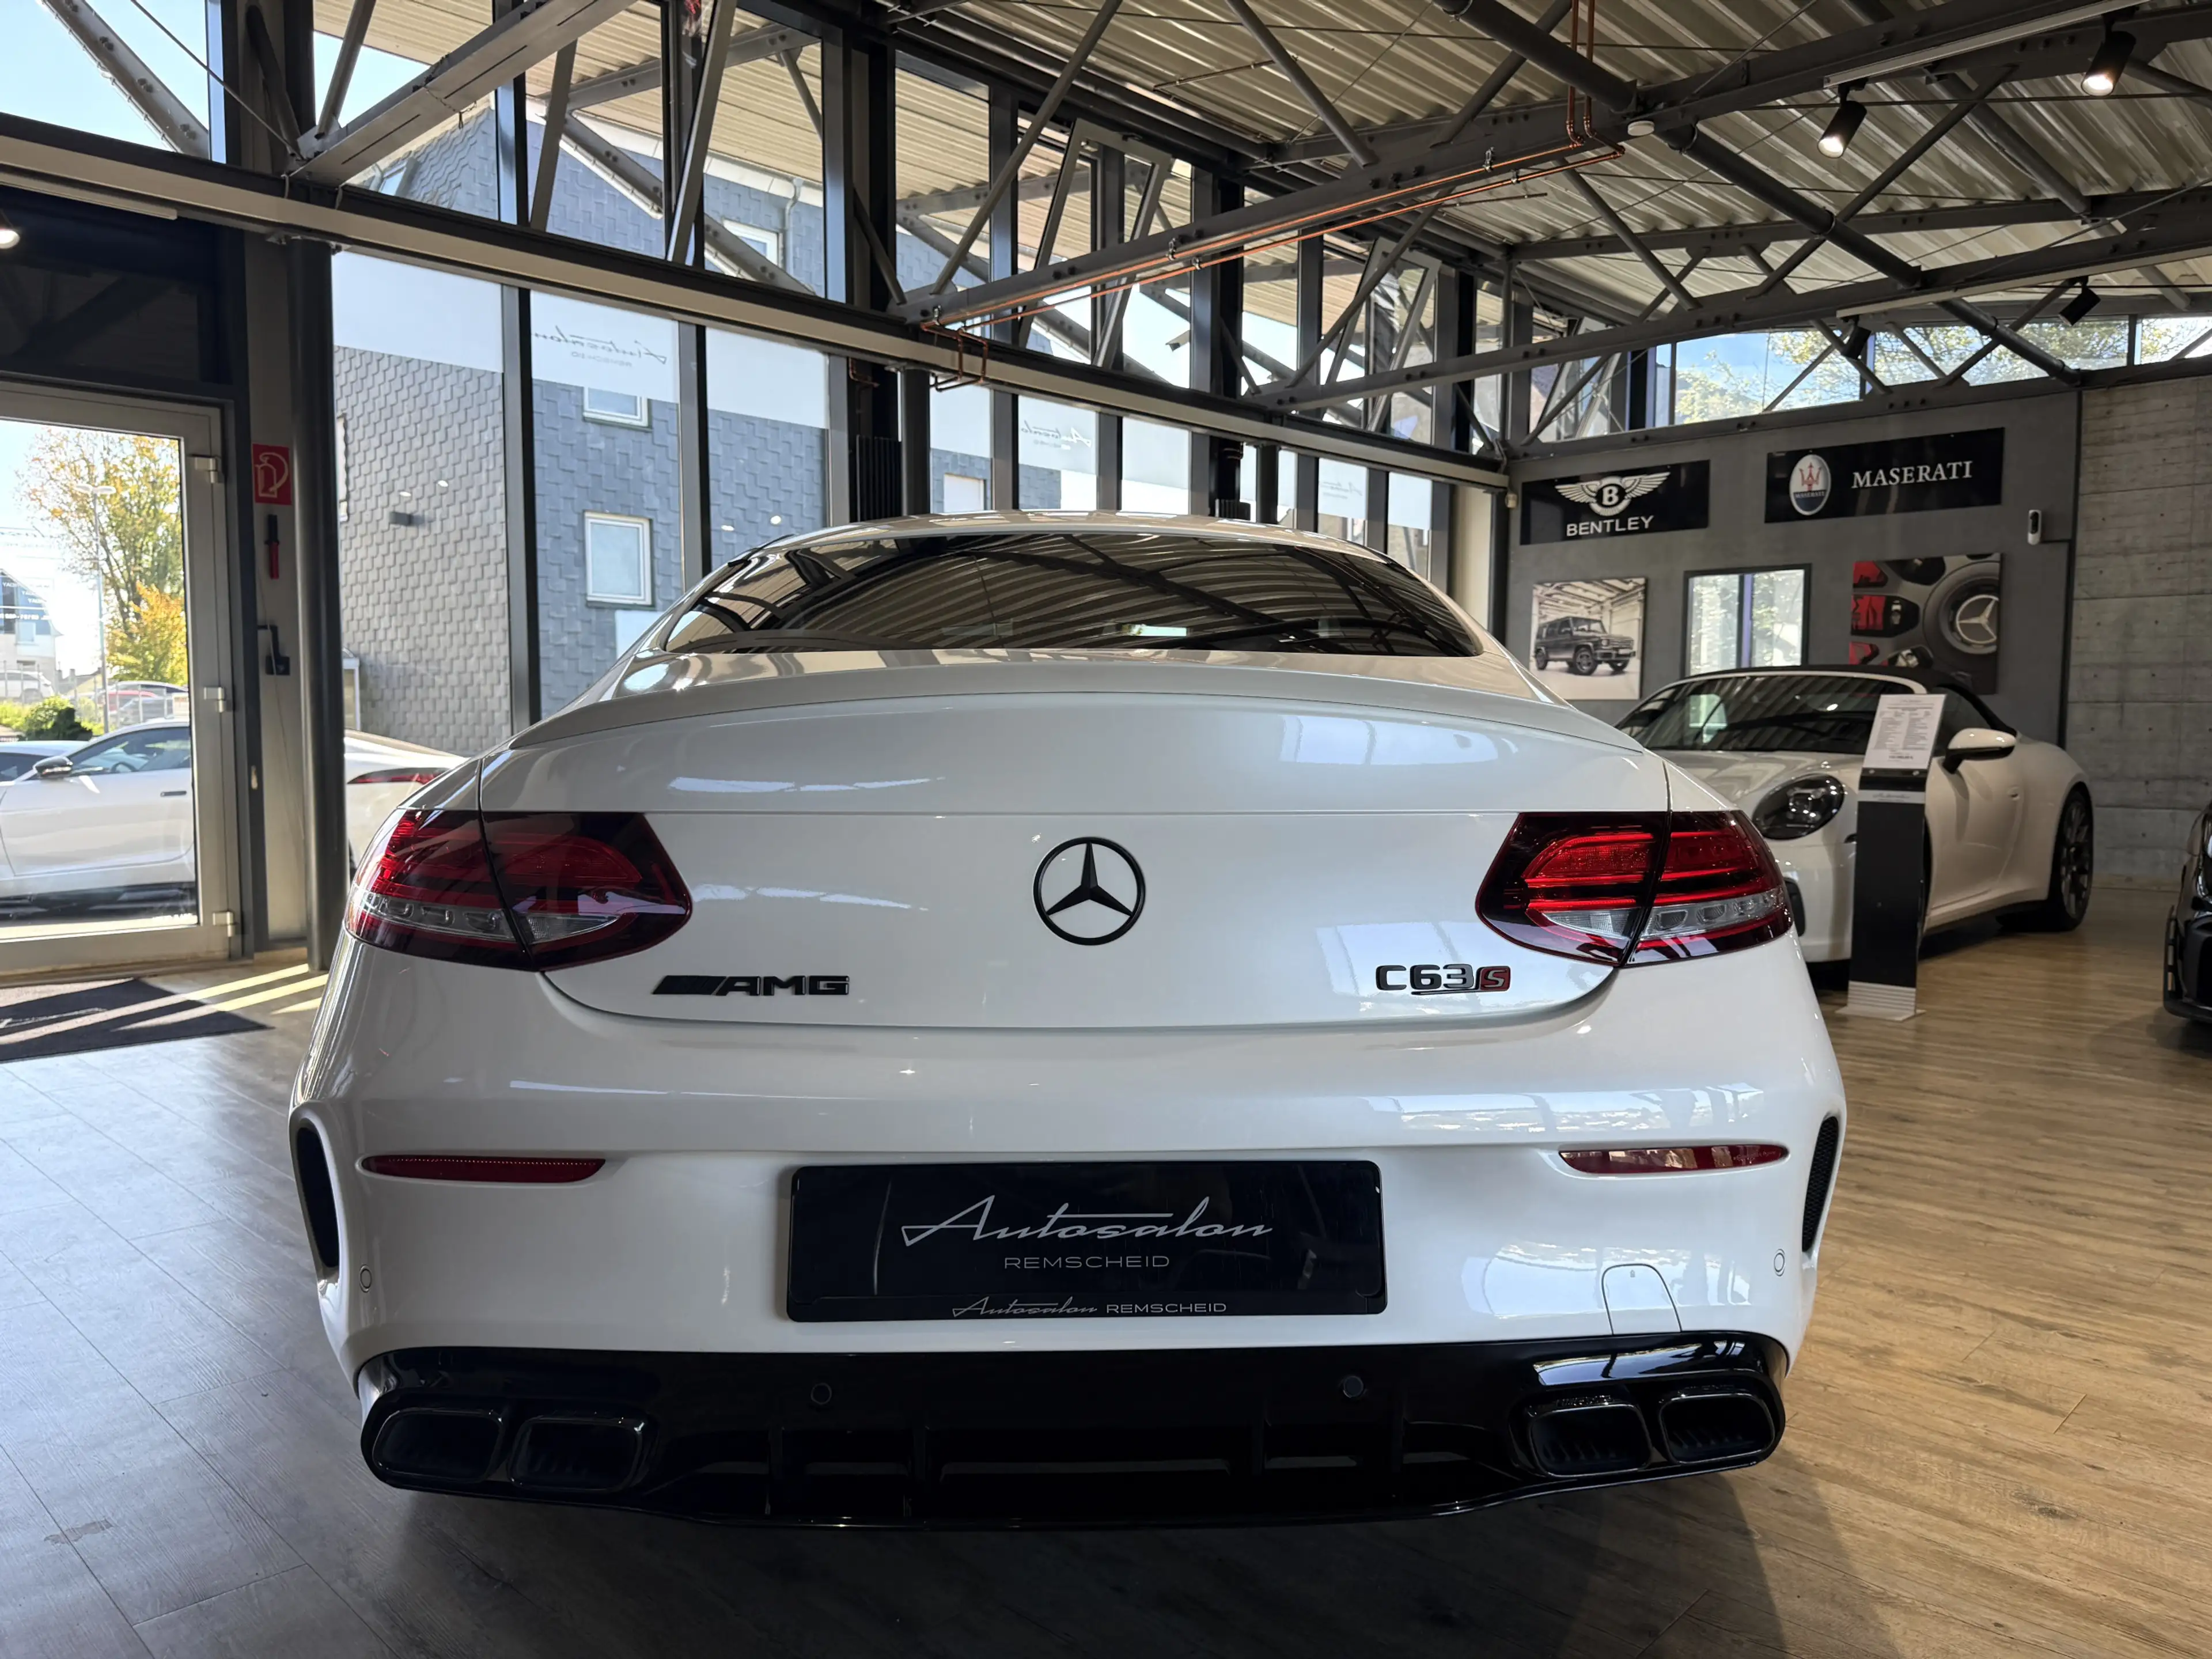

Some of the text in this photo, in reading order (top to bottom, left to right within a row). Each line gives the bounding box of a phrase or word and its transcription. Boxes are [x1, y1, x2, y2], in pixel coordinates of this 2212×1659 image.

[1851, 461, 1974, 488] MASERATI
[1602, 486, 1619, 505] B
[1566, 515, 1654, 537] BENTLEY
[715, 975, 850, 996] AMG
[901, 1195, 1273, 1247] Autosalon
[1004, 1256, 1170, 1269] REMSCHEID
[952, 1296, 1226, 1317] Autosalon REMSCHEID
